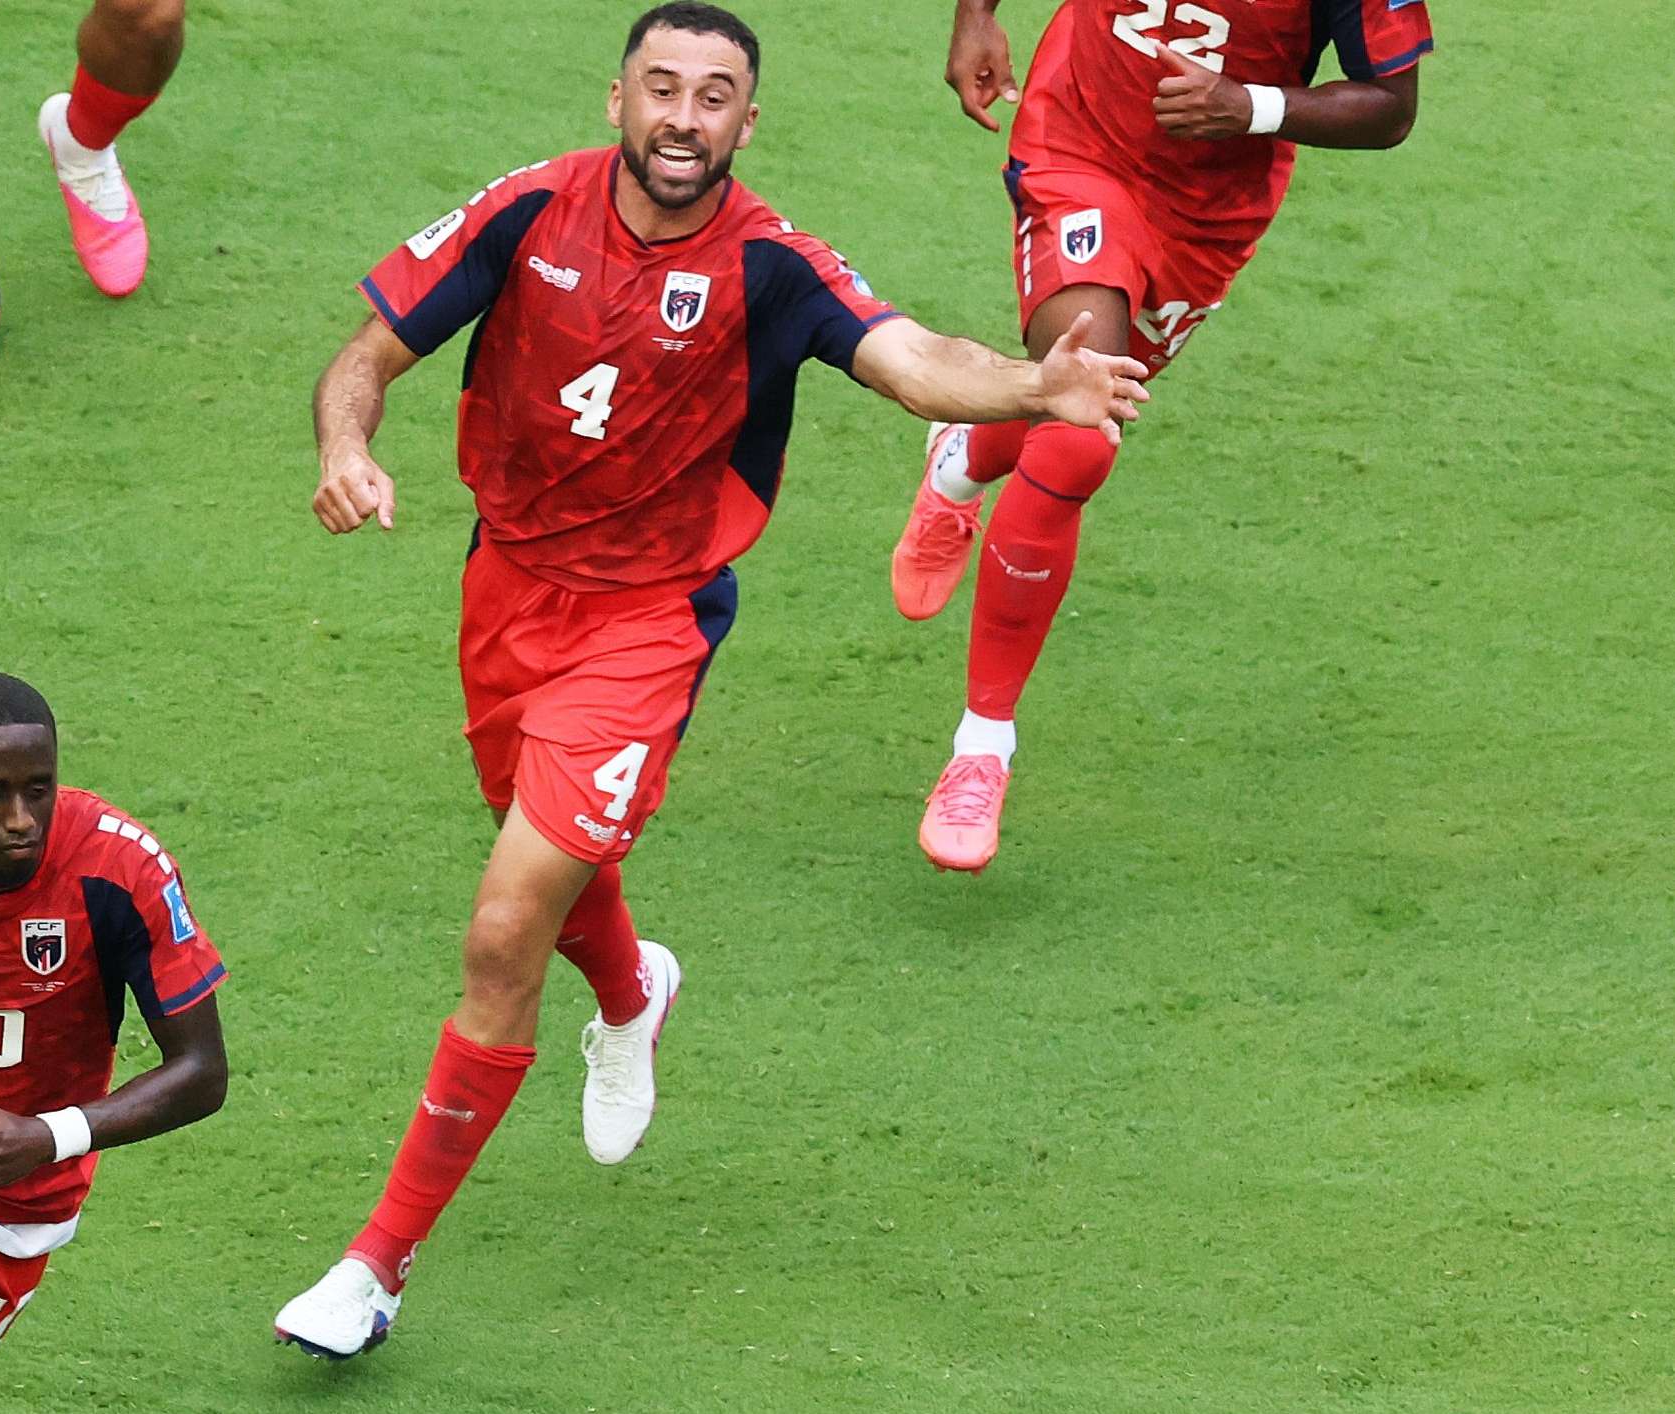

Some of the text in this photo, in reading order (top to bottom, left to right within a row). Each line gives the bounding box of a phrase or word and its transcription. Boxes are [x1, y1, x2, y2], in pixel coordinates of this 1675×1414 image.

[1112, 0, 1231, 75] 22
[559, 361, 620, 440] 4
[593, 741, 650, 821] 4
[25, 922, 62, 931] FCF
